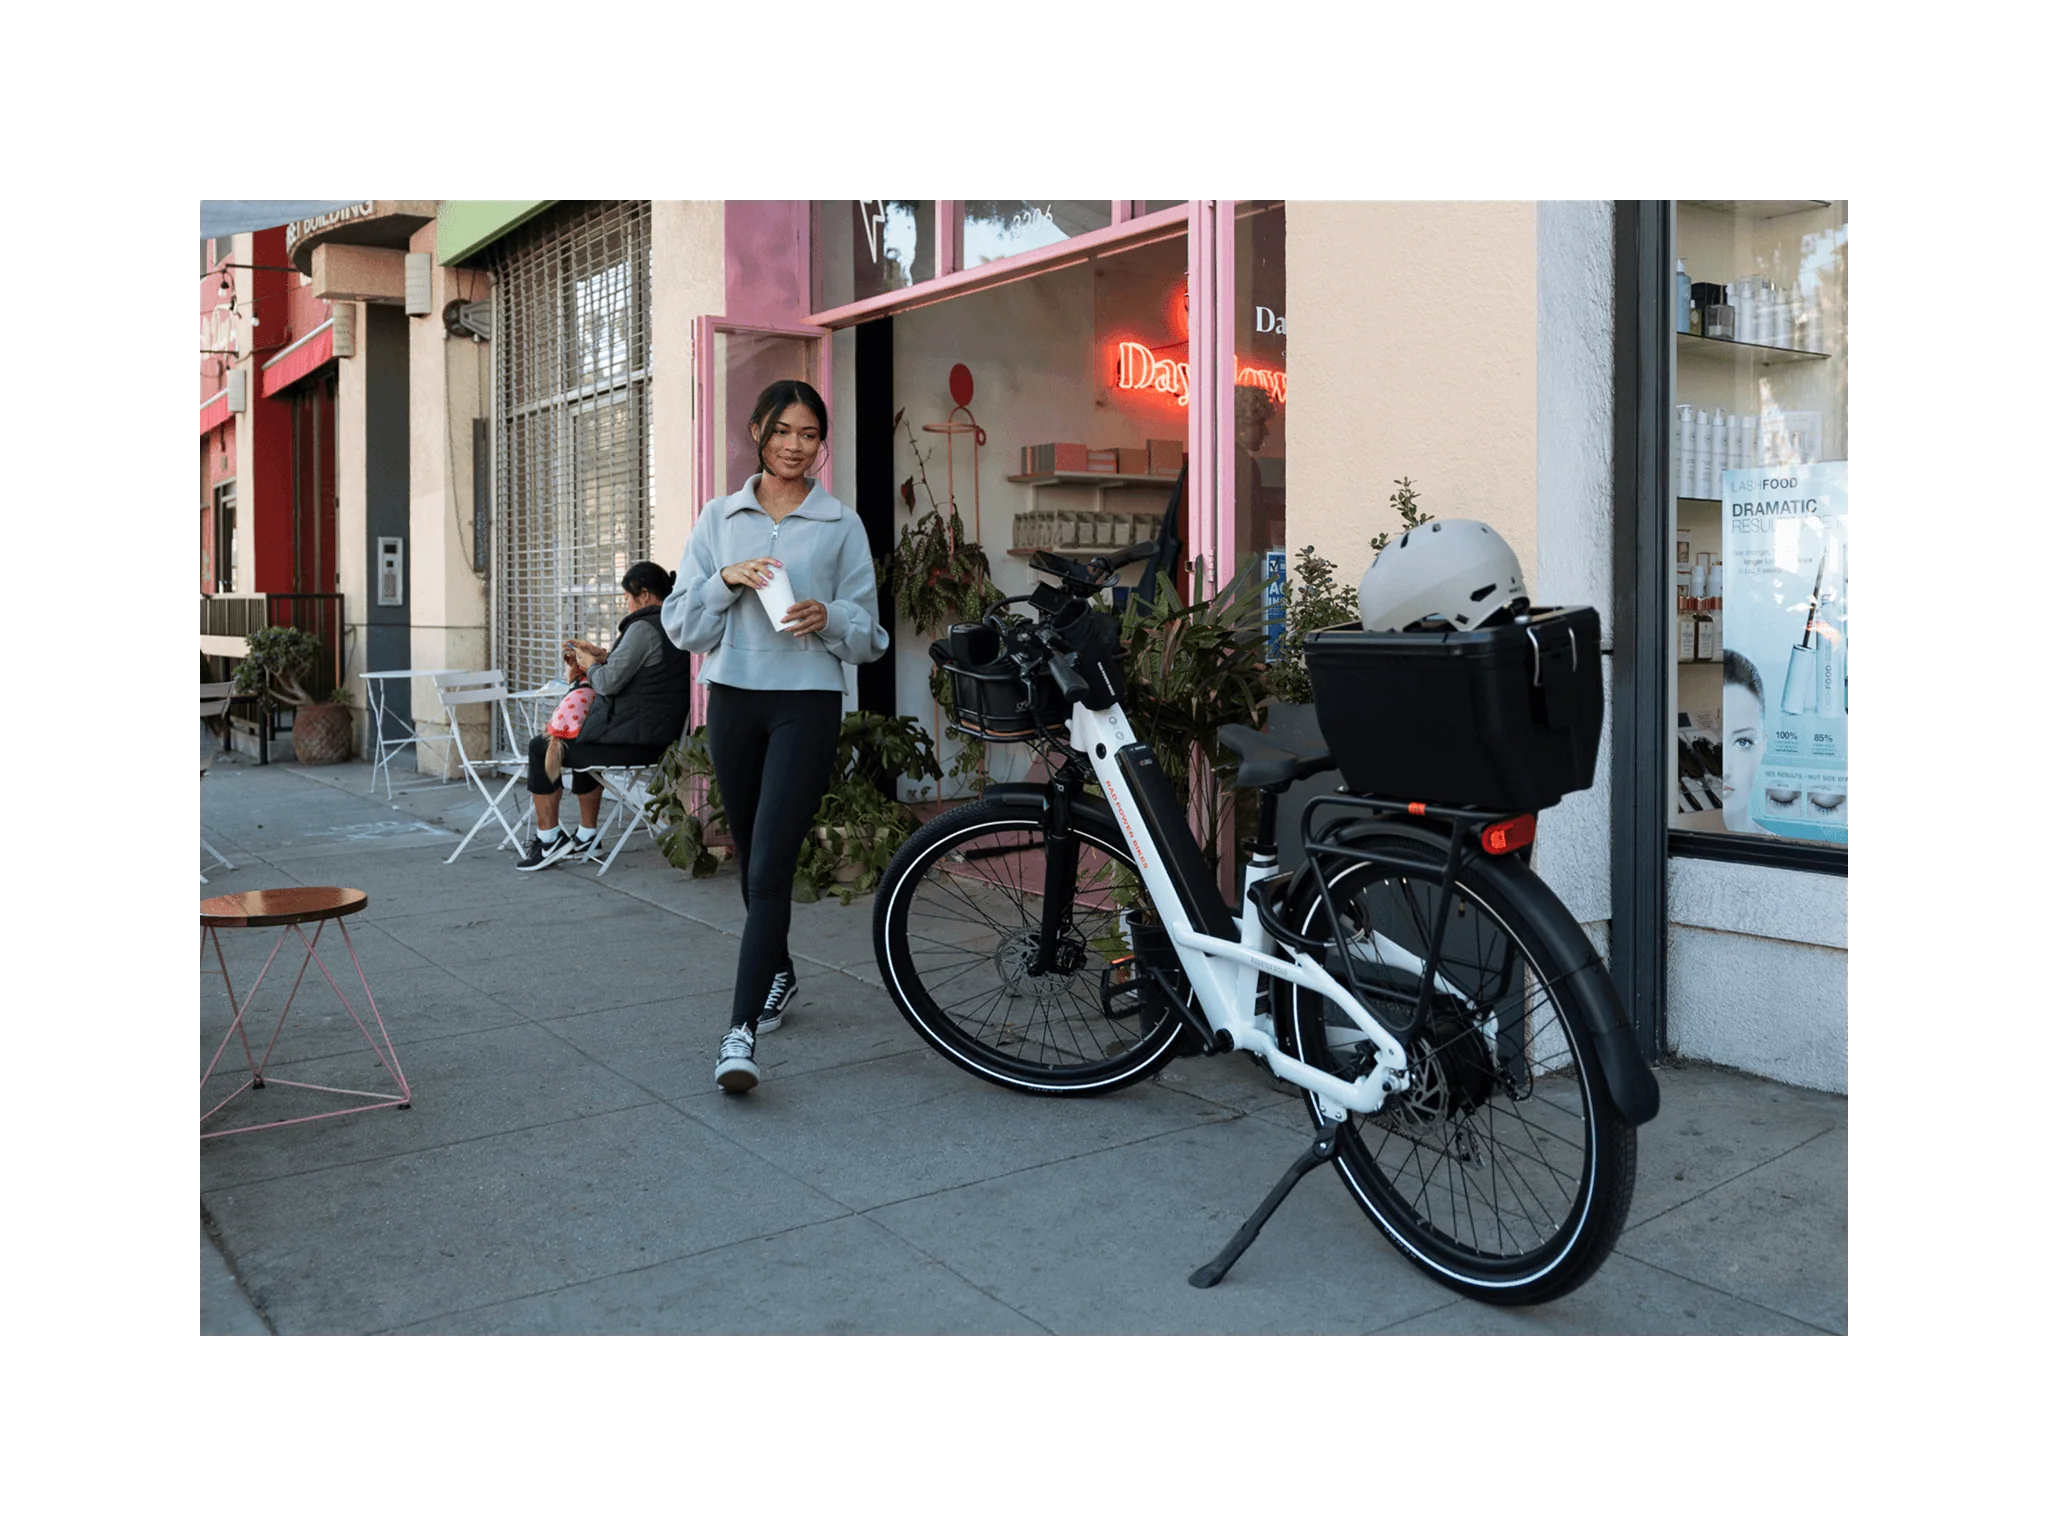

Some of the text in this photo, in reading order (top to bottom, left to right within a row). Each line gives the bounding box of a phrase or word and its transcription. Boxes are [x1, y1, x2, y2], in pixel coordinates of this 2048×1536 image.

[1732, 498, 1817, 517] DRAMATIC
[1776, 731, 1798, 740] 100%
[1813, 733, 1833, 743] 85%
[1106, 780, 1149, 869] RAD POWER BIKES
